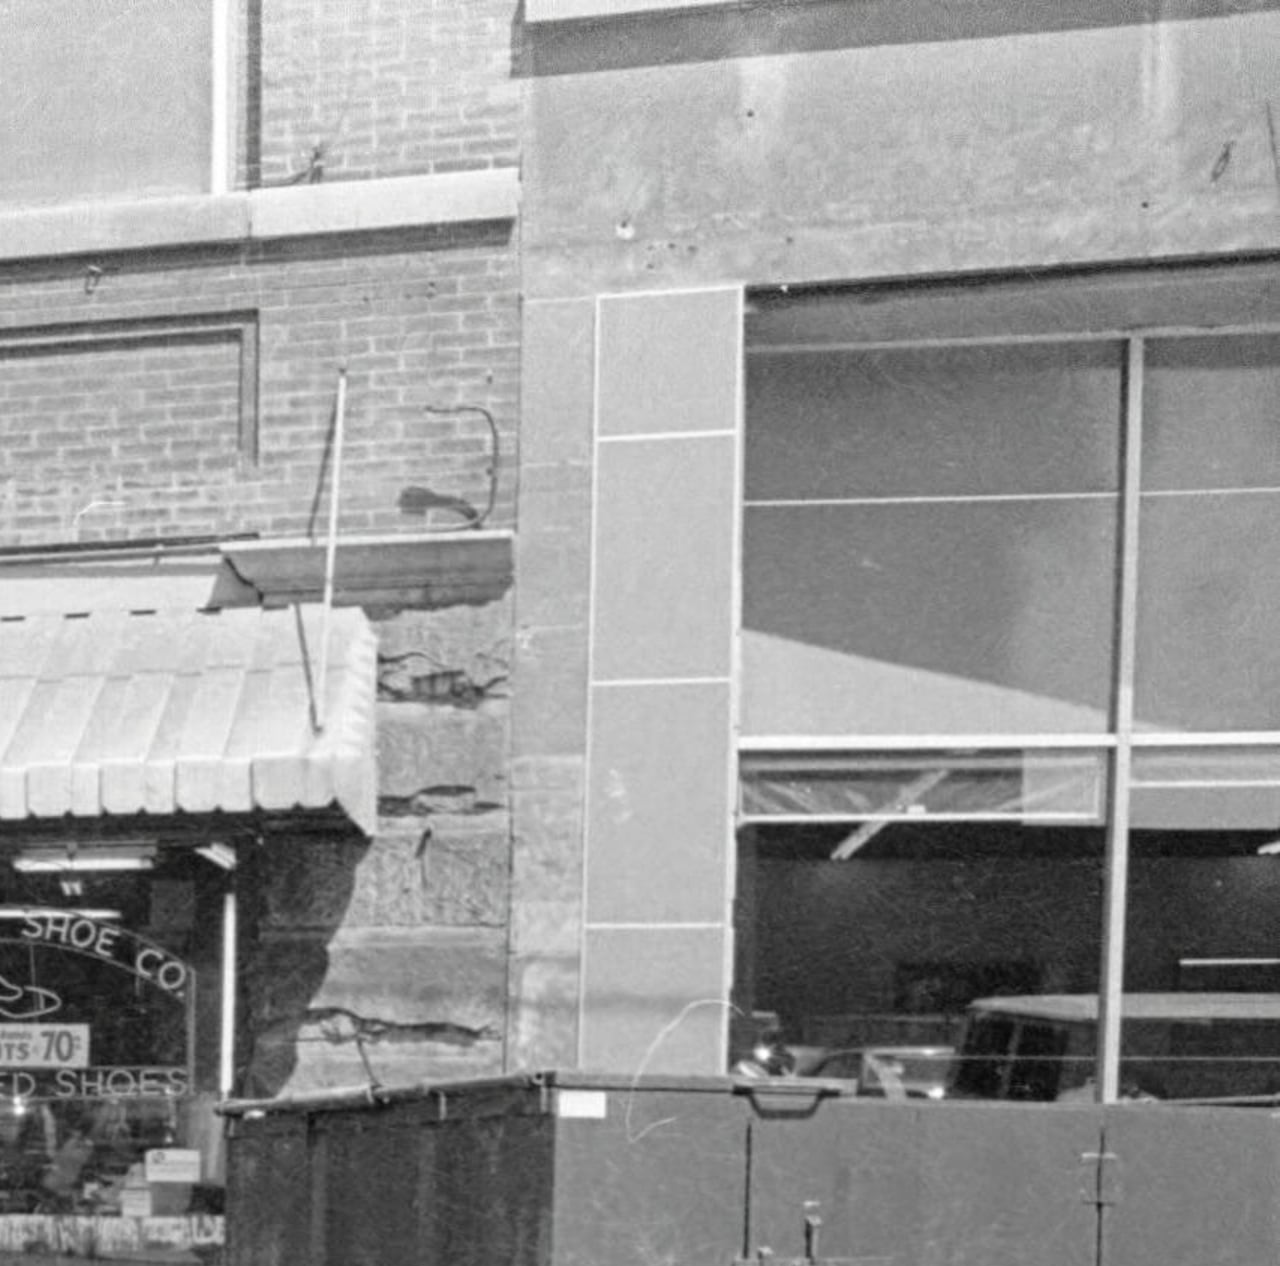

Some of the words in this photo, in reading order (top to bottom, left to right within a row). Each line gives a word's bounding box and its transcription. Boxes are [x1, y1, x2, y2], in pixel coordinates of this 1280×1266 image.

[20, 912, 122, 959] SHOE
[135, 948, 187, 998] CO.
[40, 1030, 74, 1062] 70
[55, 1069, 188, 1097] SHOES
